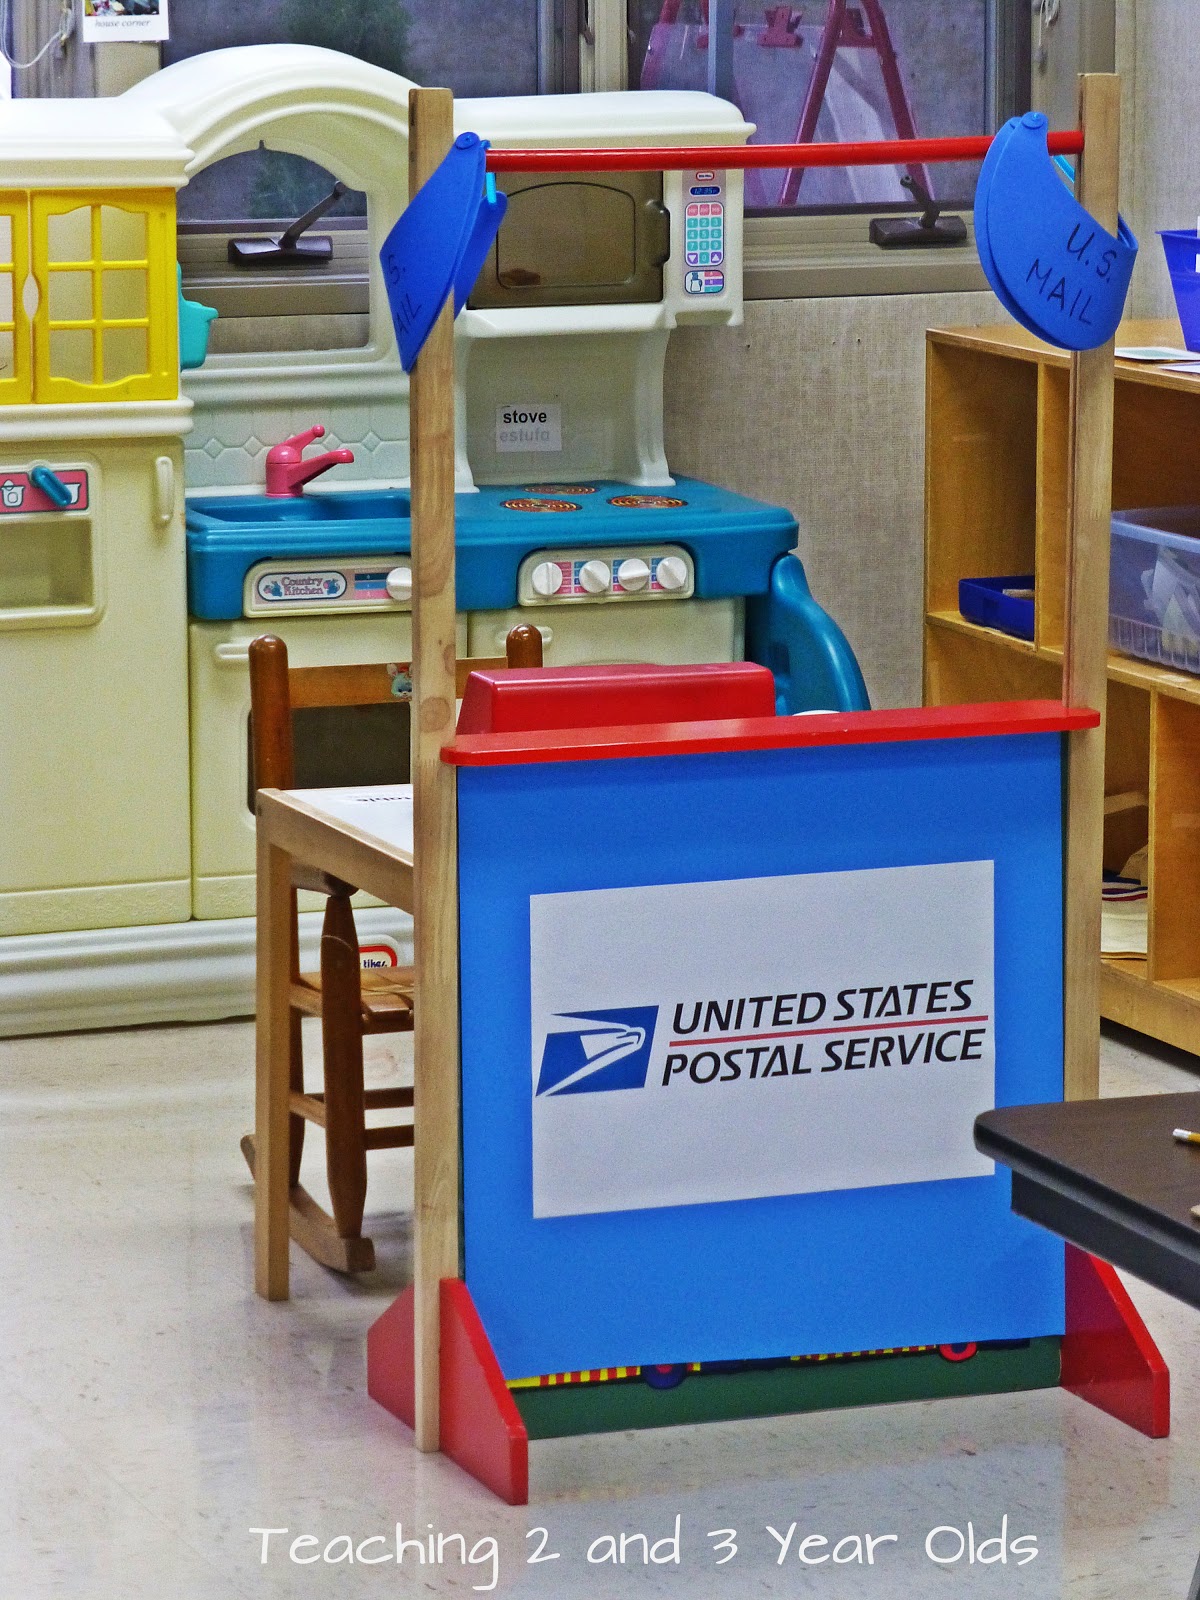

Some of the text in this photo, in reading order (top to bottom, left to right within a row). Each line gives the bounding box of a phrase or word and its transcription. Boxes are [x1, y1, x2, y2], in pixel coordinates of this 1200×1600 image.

[95, 18, 151, 28] house corner
[1066, 223, 1117, 284] U.S.
[1025, 258, 1093, 326] MAIL
[396, 292, 423, 335] AIL
[503, 410, 547, 424] stove
[499, 427, 550, 442] estufa
[281, 576, 324, 589] Country
[283, 584, 324, 596] Kitchen
[672, 979, 974, 1035] UNITED STATES
[661, 1028, 986, 1086] POSTAL SERVICE
